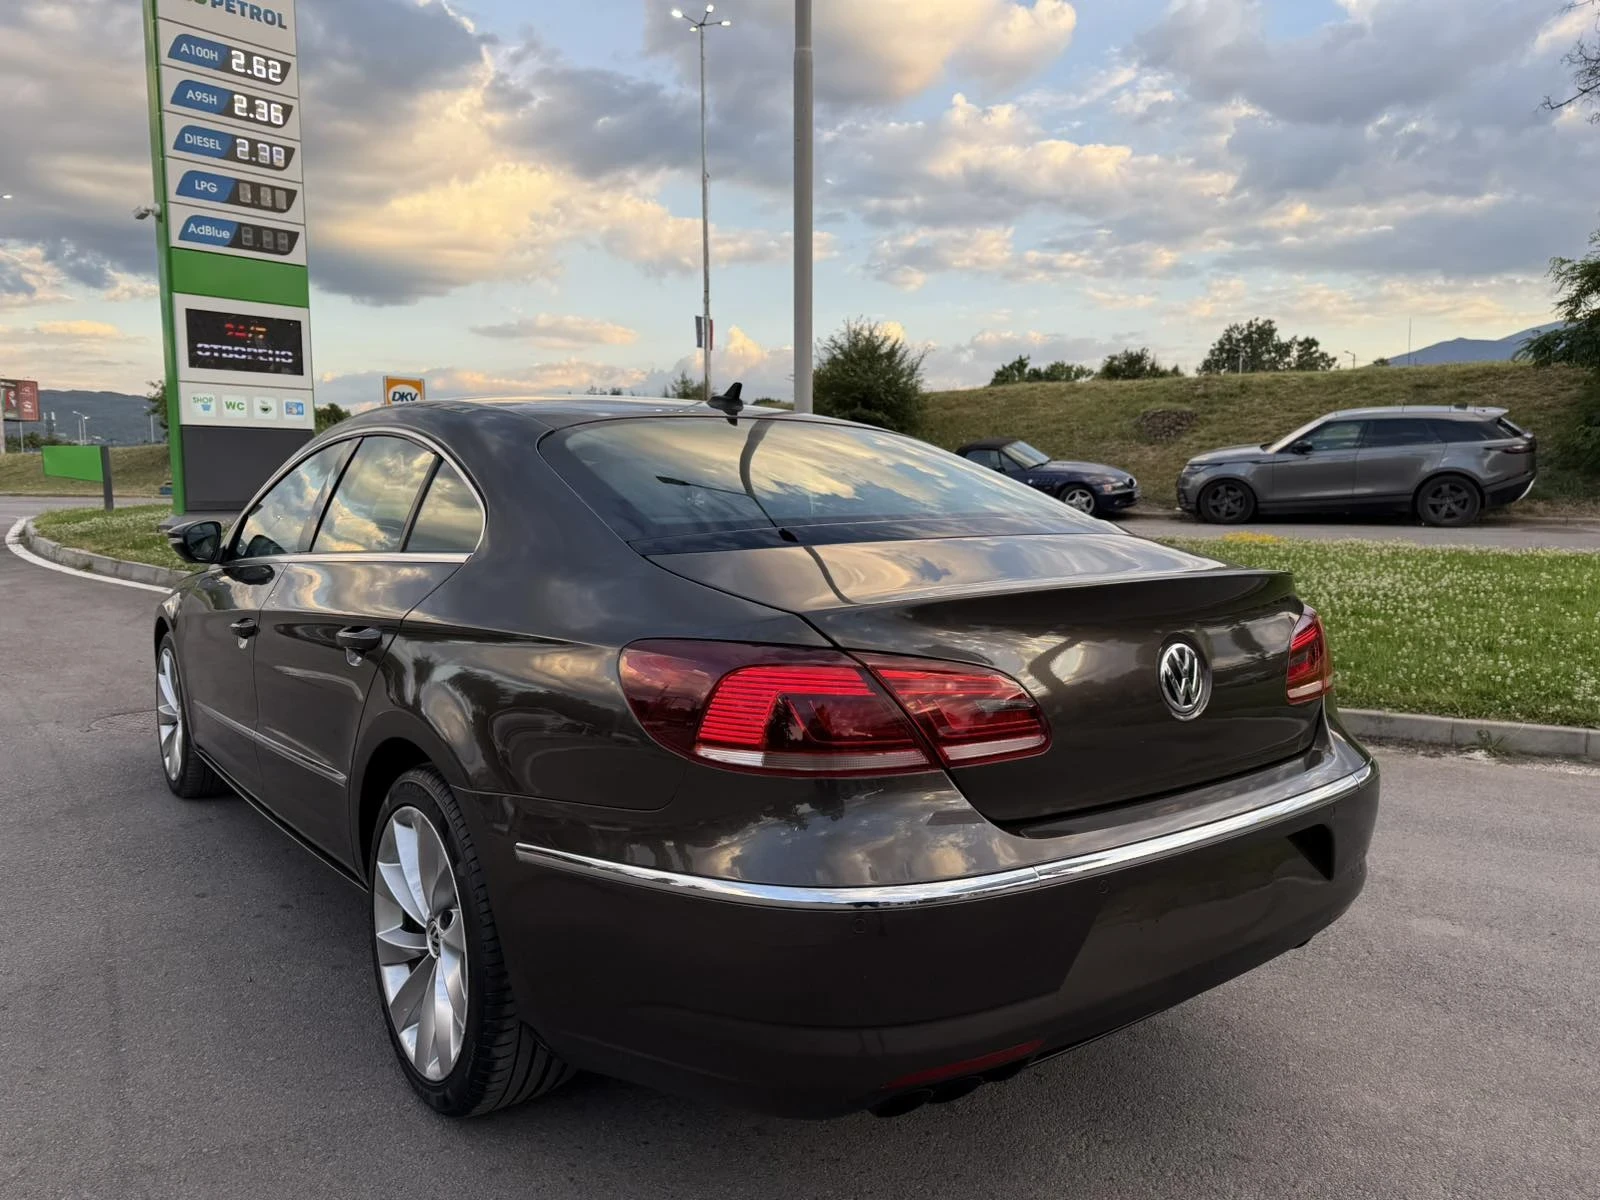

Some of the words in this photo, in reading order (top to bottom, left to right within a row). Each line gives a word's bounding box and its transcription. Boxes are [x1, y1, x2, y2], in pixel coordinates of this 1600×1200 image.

[180, 43, 219, 61] A100H
[231, 50, 282, 82] 2.62
[186, 89, 217, 105] A95H
[233, 94, 284, 125] 2.36
[184, 133, 222, 151] DIESEL
[194, 179, 218, 193] LPG
[188, 223, 230, 239] AdBlue
[192, 396, 214, 404] SHOP
[391, 391, 418, 402] DKV
[225, 400, 245, 411] WC
